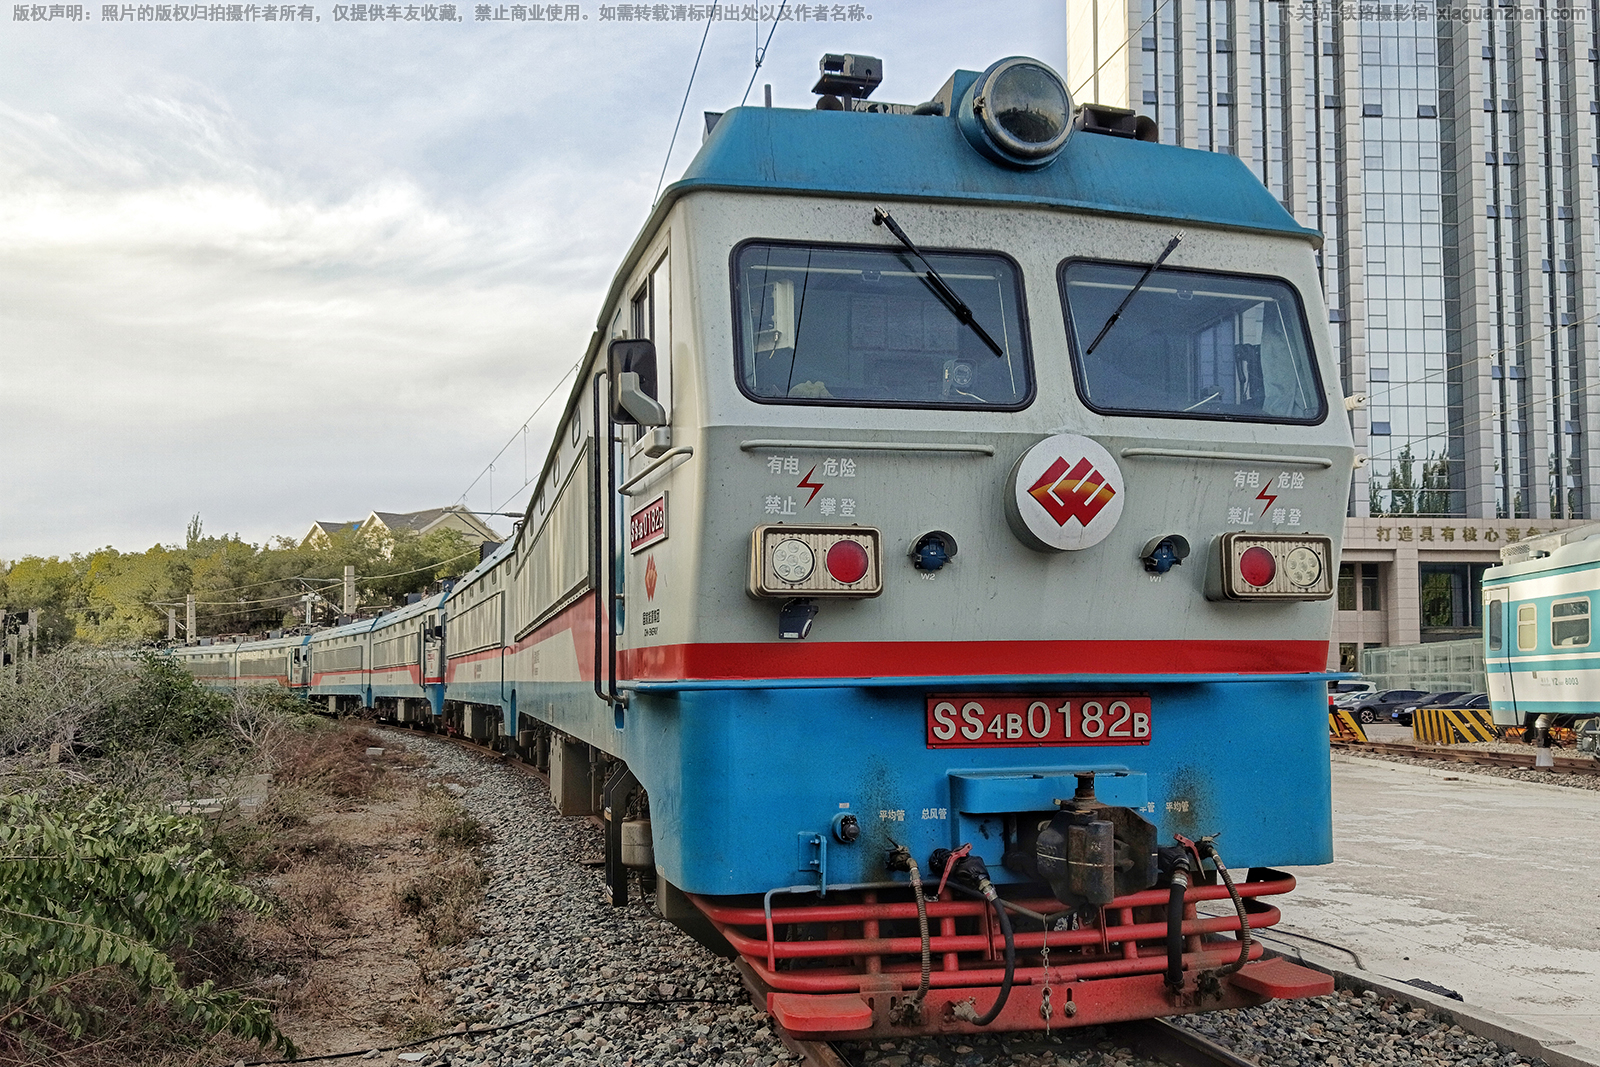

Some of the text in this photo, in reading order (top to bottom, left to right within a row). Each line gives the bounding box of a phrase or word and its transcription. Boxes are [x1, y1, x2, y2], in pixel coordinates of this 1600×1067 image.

[767, 455, 856, 477] 有电 危险
[1233, 470, 1305, 489] 有电 危险
[764, 495, 856, 517] 禁止 攀登
[1227, 507, 1301, 526] 禁止 攀登
[920, 572, 936, 581] W2
[932, 700, 1150, 741] SS4B0182B
[879, 809, 906, 821] 平均管
[921, 807, 947, 820] 总风管
[1165, 800, 1189, 813] 平均管
